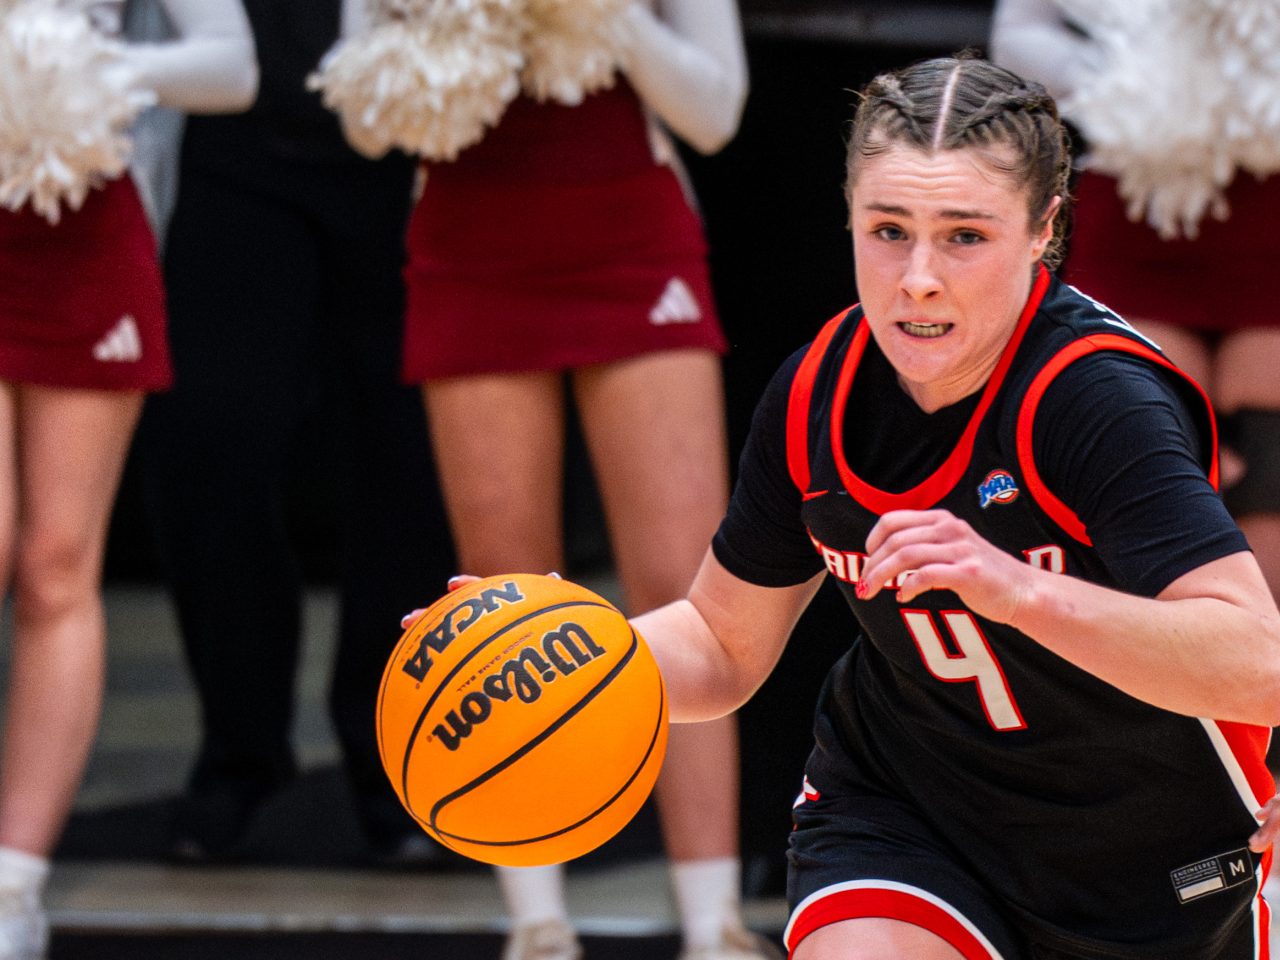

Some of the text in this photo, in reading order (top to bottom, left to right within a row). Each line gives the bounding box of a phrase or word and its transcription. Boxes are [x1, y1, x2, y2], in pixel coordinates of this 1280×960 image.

[402, 582, 524, 683] NCAA
[431, 621, 607, 751] Wilson
[900, 608, 1028, 732] 4
[1229, 859, 1245, 876] M
